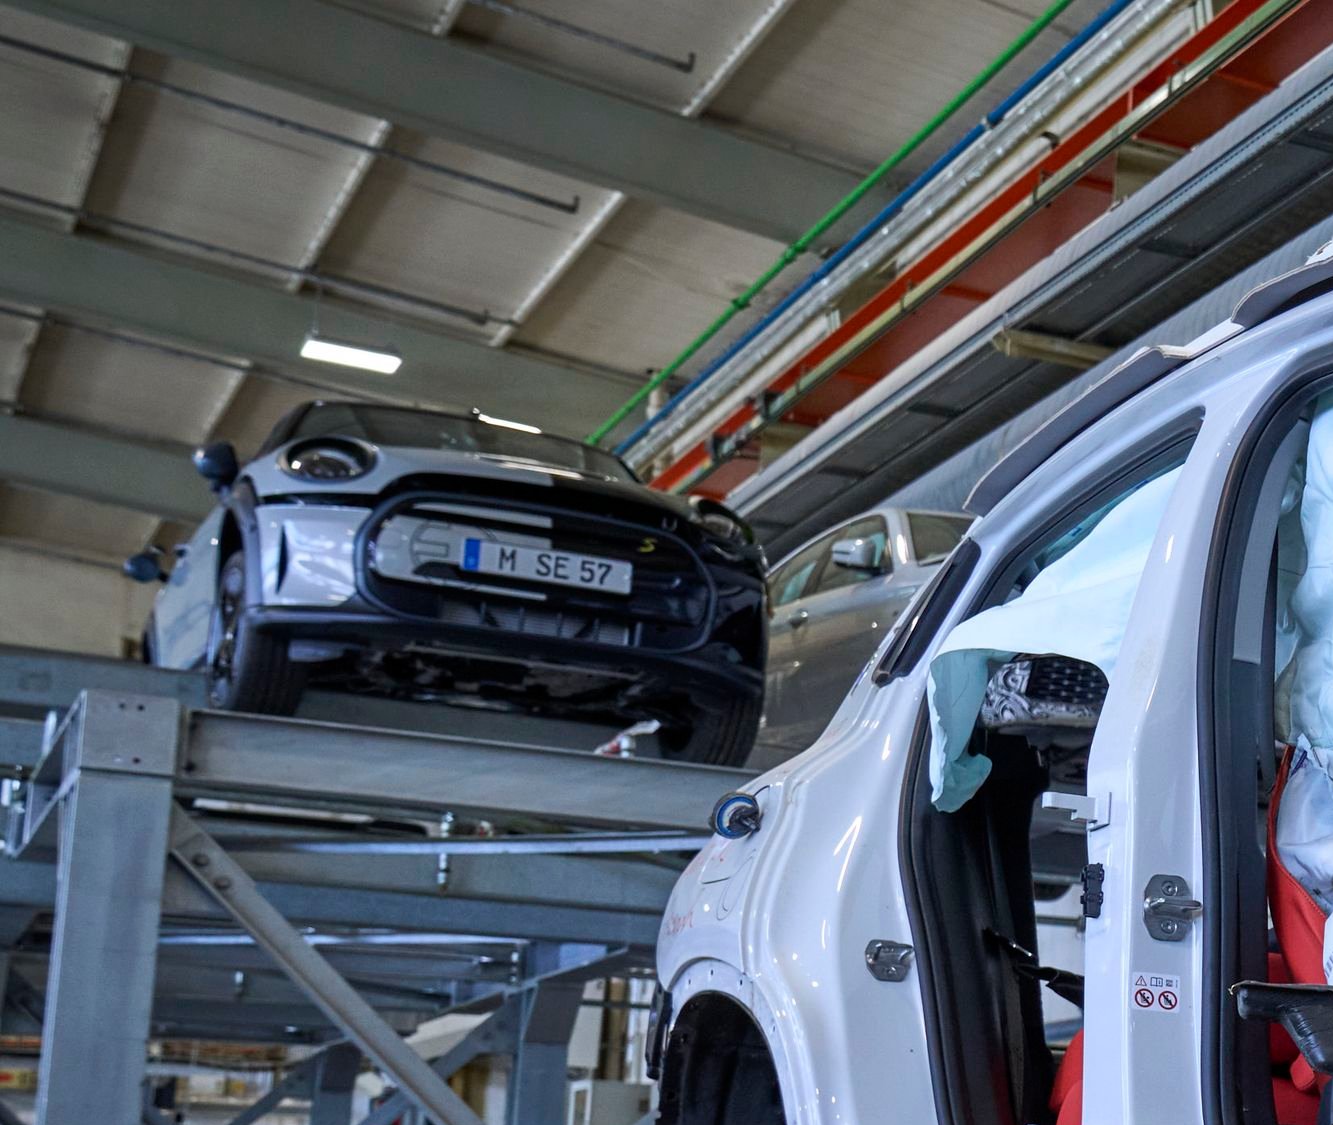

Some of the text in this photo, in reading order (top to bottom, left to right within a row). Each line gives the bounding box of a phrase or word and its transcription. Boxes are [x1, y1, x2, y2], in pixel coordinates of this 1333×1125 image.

[499, 548, 613, 585] M SE 57
